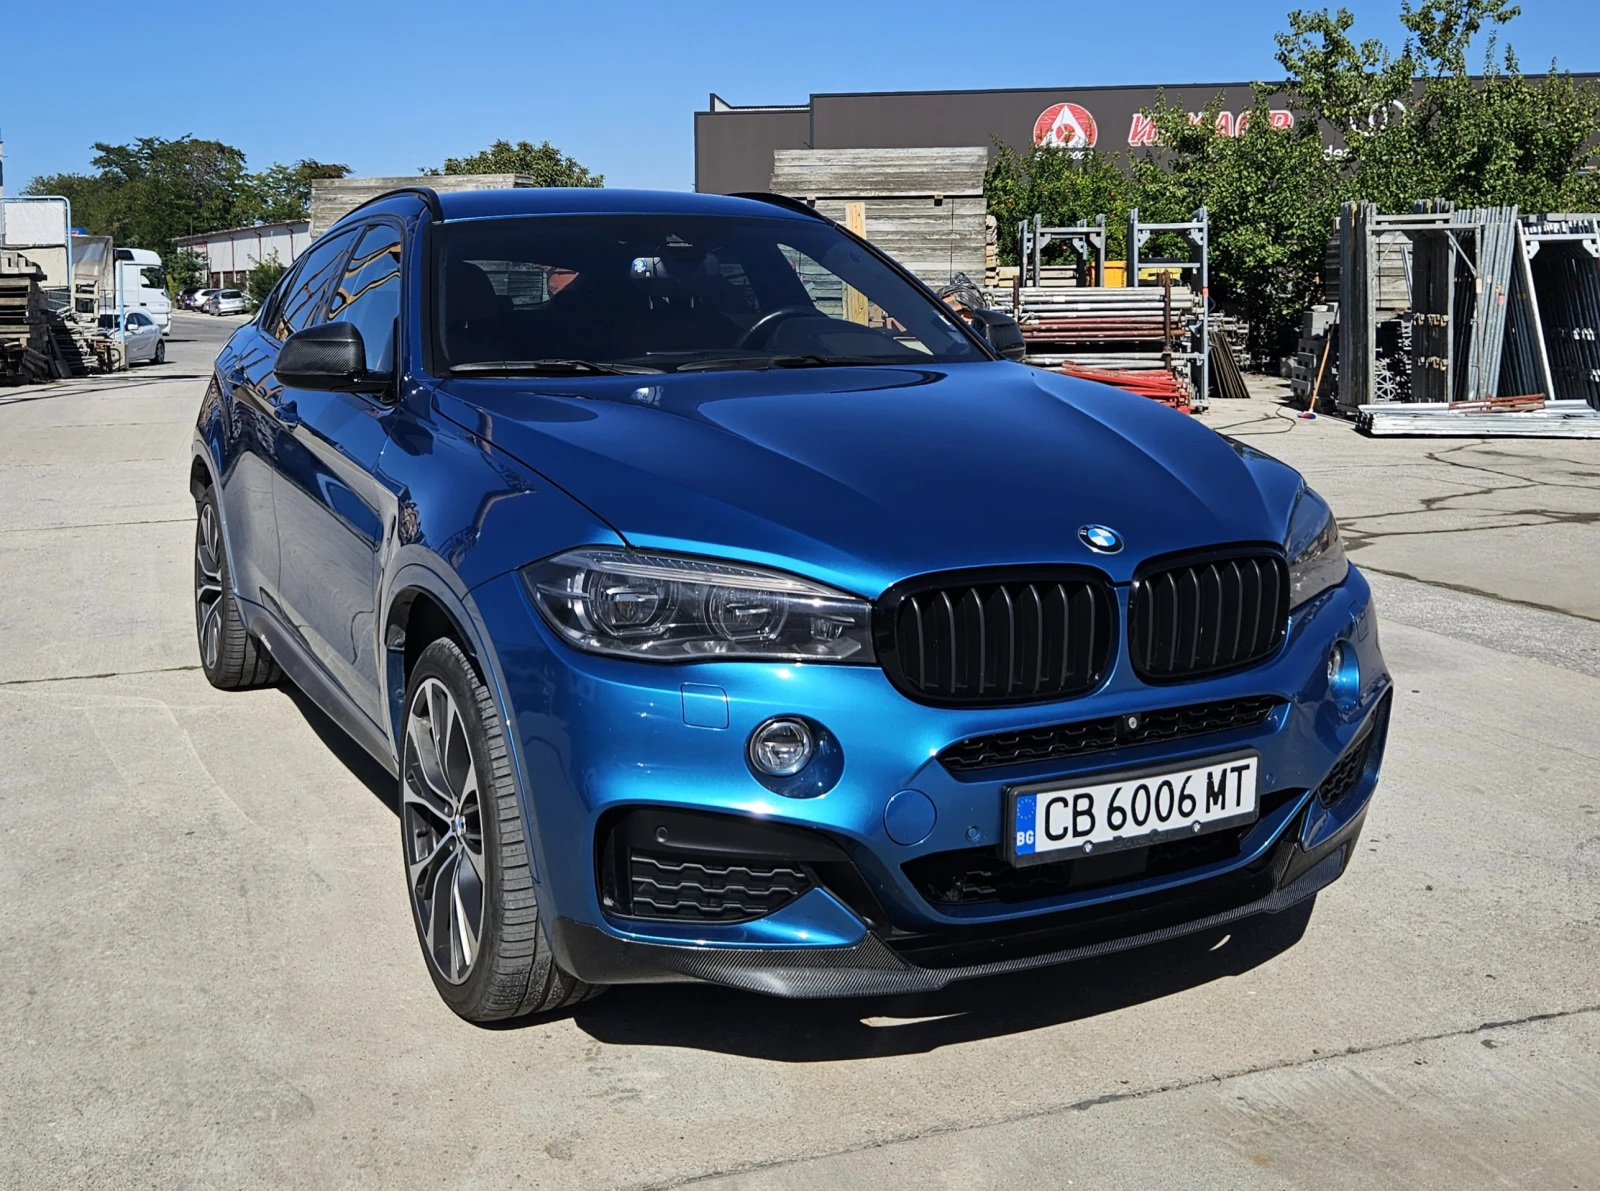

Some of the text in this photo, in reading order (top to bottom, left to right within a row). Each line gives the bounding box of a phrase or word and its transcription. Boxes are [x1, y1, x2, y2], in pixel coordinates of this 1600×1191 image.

[1045, 764, 1250, 840] CB 6006 MT
[1016, 831, 1034, 846] BG
